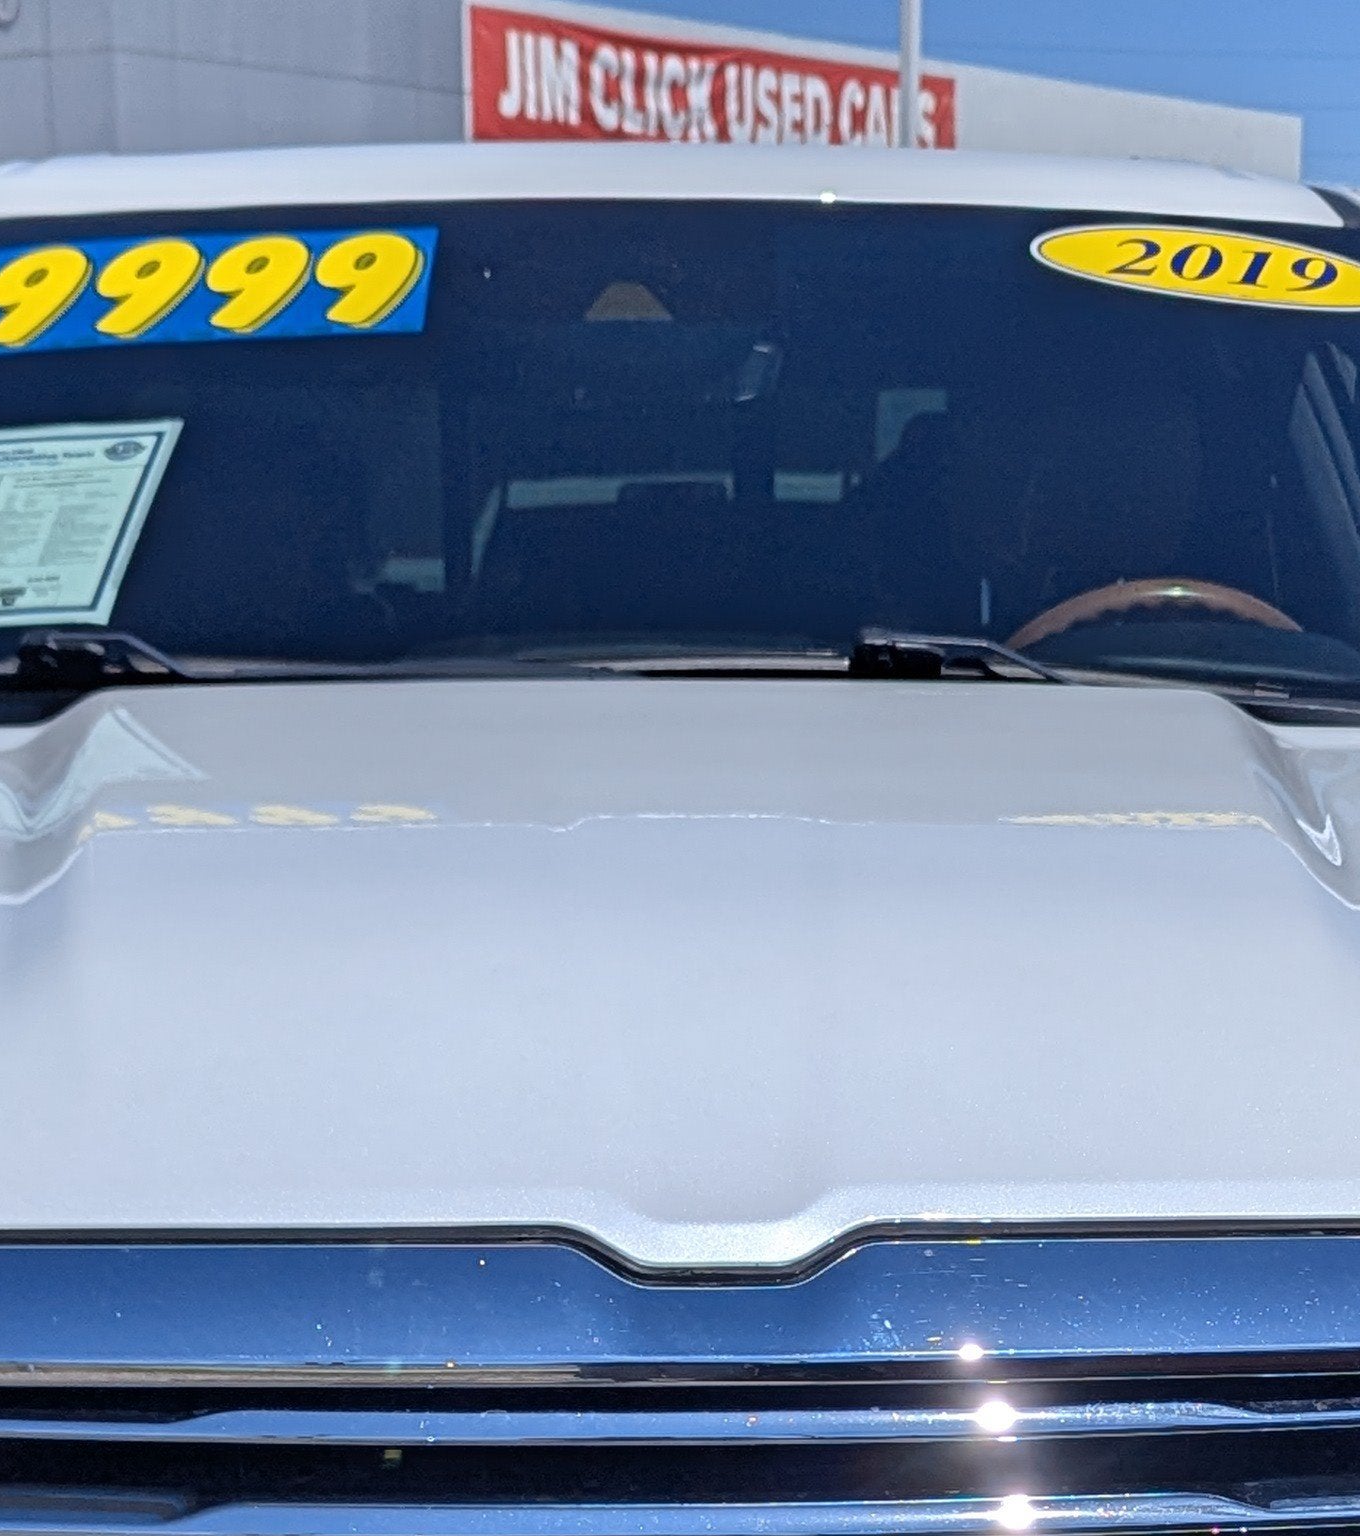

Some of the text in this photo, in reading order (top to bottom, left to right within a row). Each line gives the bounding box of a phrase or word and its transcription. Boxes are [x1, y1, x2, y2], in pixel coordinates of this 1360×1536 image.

[498, 30, 582, 127] JIM
[589, 43, 719, 142] CLICK
[725, 63, 832, 143] USED
[1107, 238, 1339, 292] 2019
